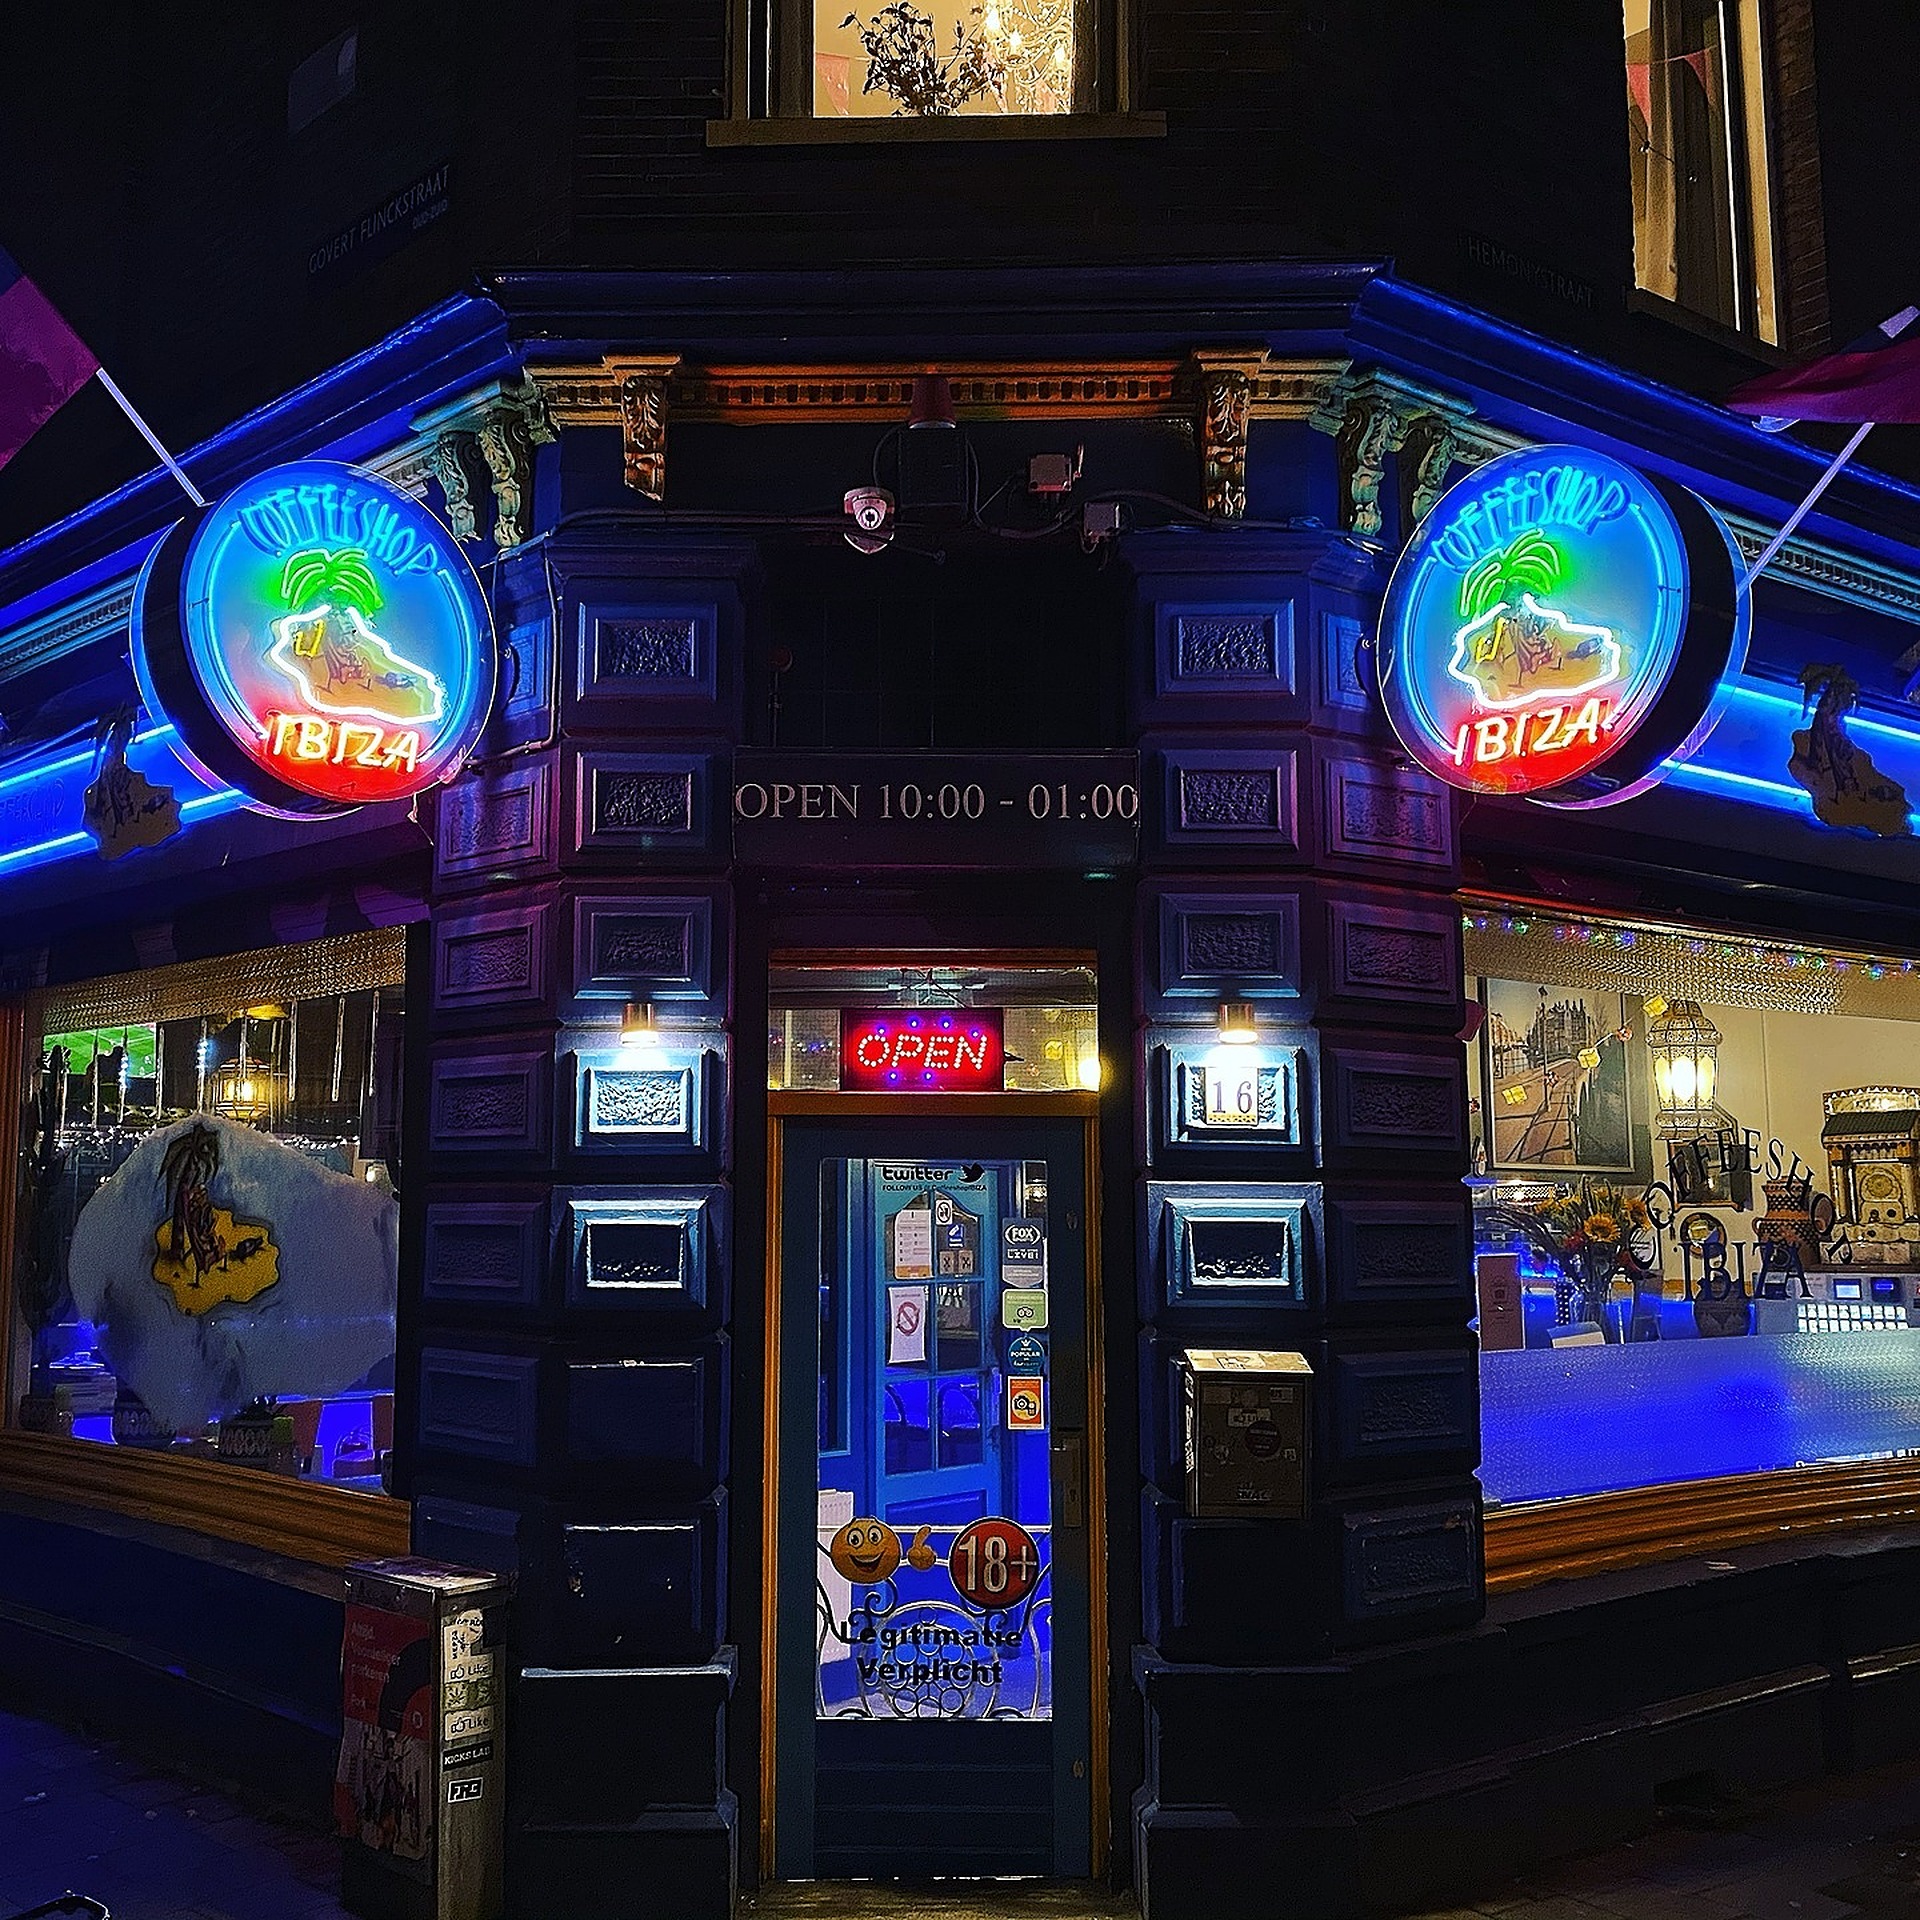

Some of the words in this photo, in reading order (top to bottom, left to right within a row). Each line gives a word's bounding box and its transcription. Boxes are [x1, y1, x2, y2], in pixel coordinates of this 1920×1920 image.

[308, 226, 357, 274] GOVERT
[360, 163, 450, 243] FLINCKSTRAAT
[240, 484, 438, 576] COFFEESHOP
[1432, 465, 1630, 572] COFFEESHOP
[268, 712, 421, 773] IBIZA
[1453, 698, 1604, 765] IBIZA
[734, 783, 860, 820] OPEN
[879, 783, 986, 820] 10:00
[1027, 783, 1139, 820] 01:00
[856, 1034, 988, 1072] OPEN
[1212, 1080, 1252, 1114] 16
[882, 1164, 955, 1182] twitter
[882, 1184, 911, 1192] FOLLOW
[1629, 1127, 1853, 1270] COFFEESHOP
[1012, 1227, 1034, 1238] FOX
[957, 1535, 1037, 1595] 18+
[840, 1619, 1024, 1651] Legitimatie
[857, 1654, 1004, 1686] Verplicht
[468, 1716, 489, 1729] Like
